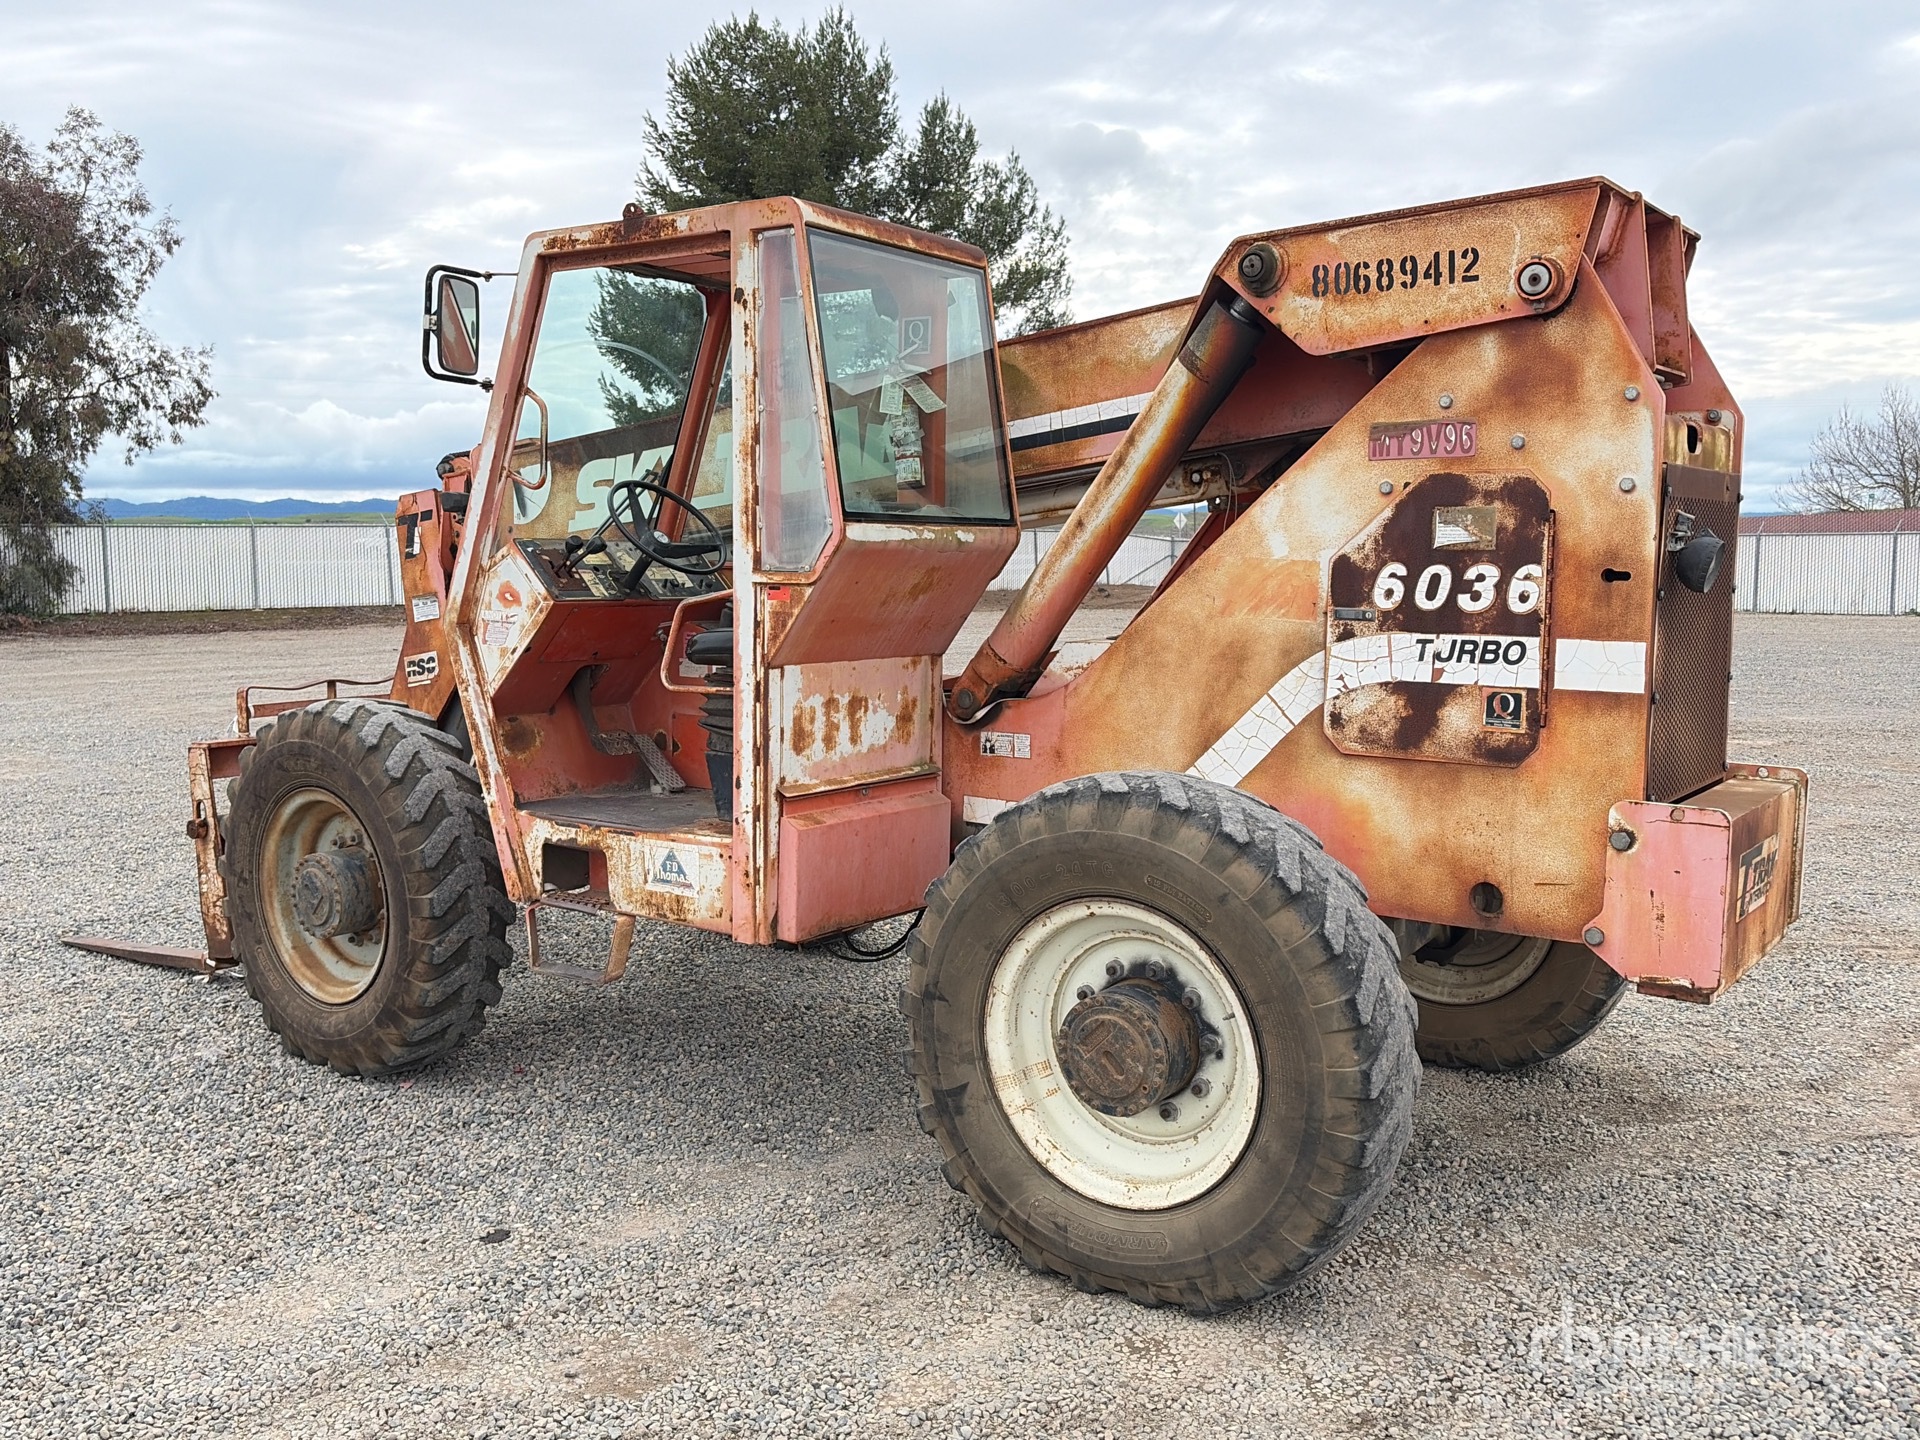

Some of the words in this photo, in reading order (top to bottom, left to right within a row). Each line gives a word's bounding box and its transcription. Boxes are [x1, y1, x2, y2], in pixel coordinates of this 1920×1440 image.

[1312, 247, 1480, 297] 80689412
[1372, 561, 1543, 615] 6036
[1415, 637, 1527, 666] TURBO
